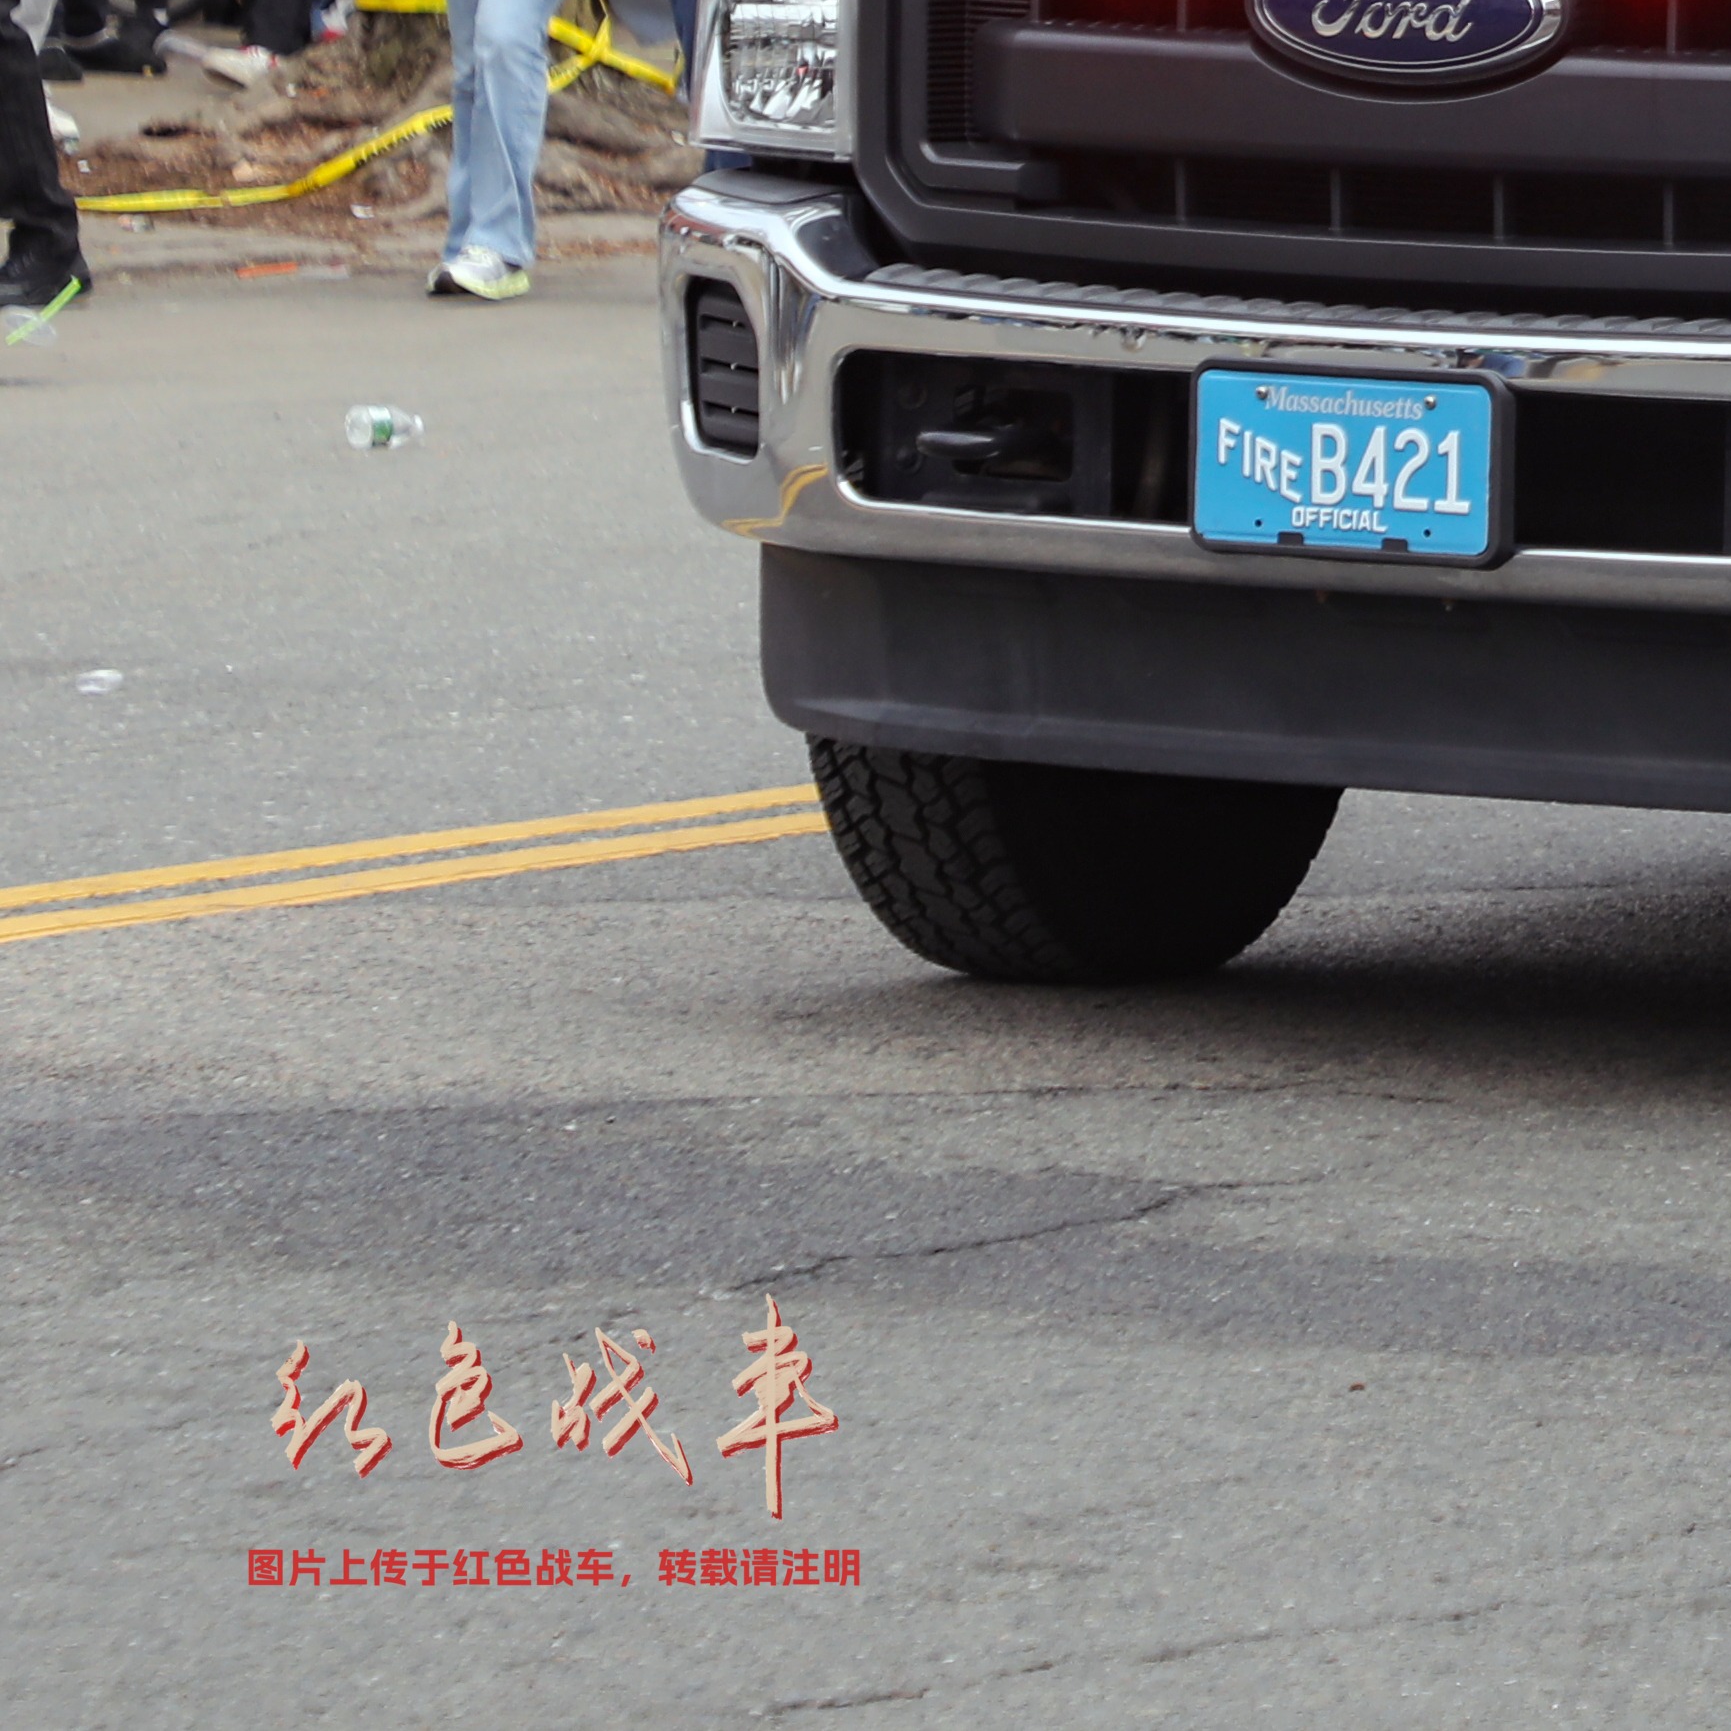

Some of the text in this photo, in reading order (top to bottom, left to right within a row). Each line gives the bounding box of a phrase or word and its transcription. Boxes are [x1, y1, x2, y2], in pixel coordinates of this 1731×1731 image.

[1264, 385, 1424, 421] Massachusetts
[1217, 417, 1472, 515] FIRE B421
[1291, 505, 1389, 534] OFFICIAL
